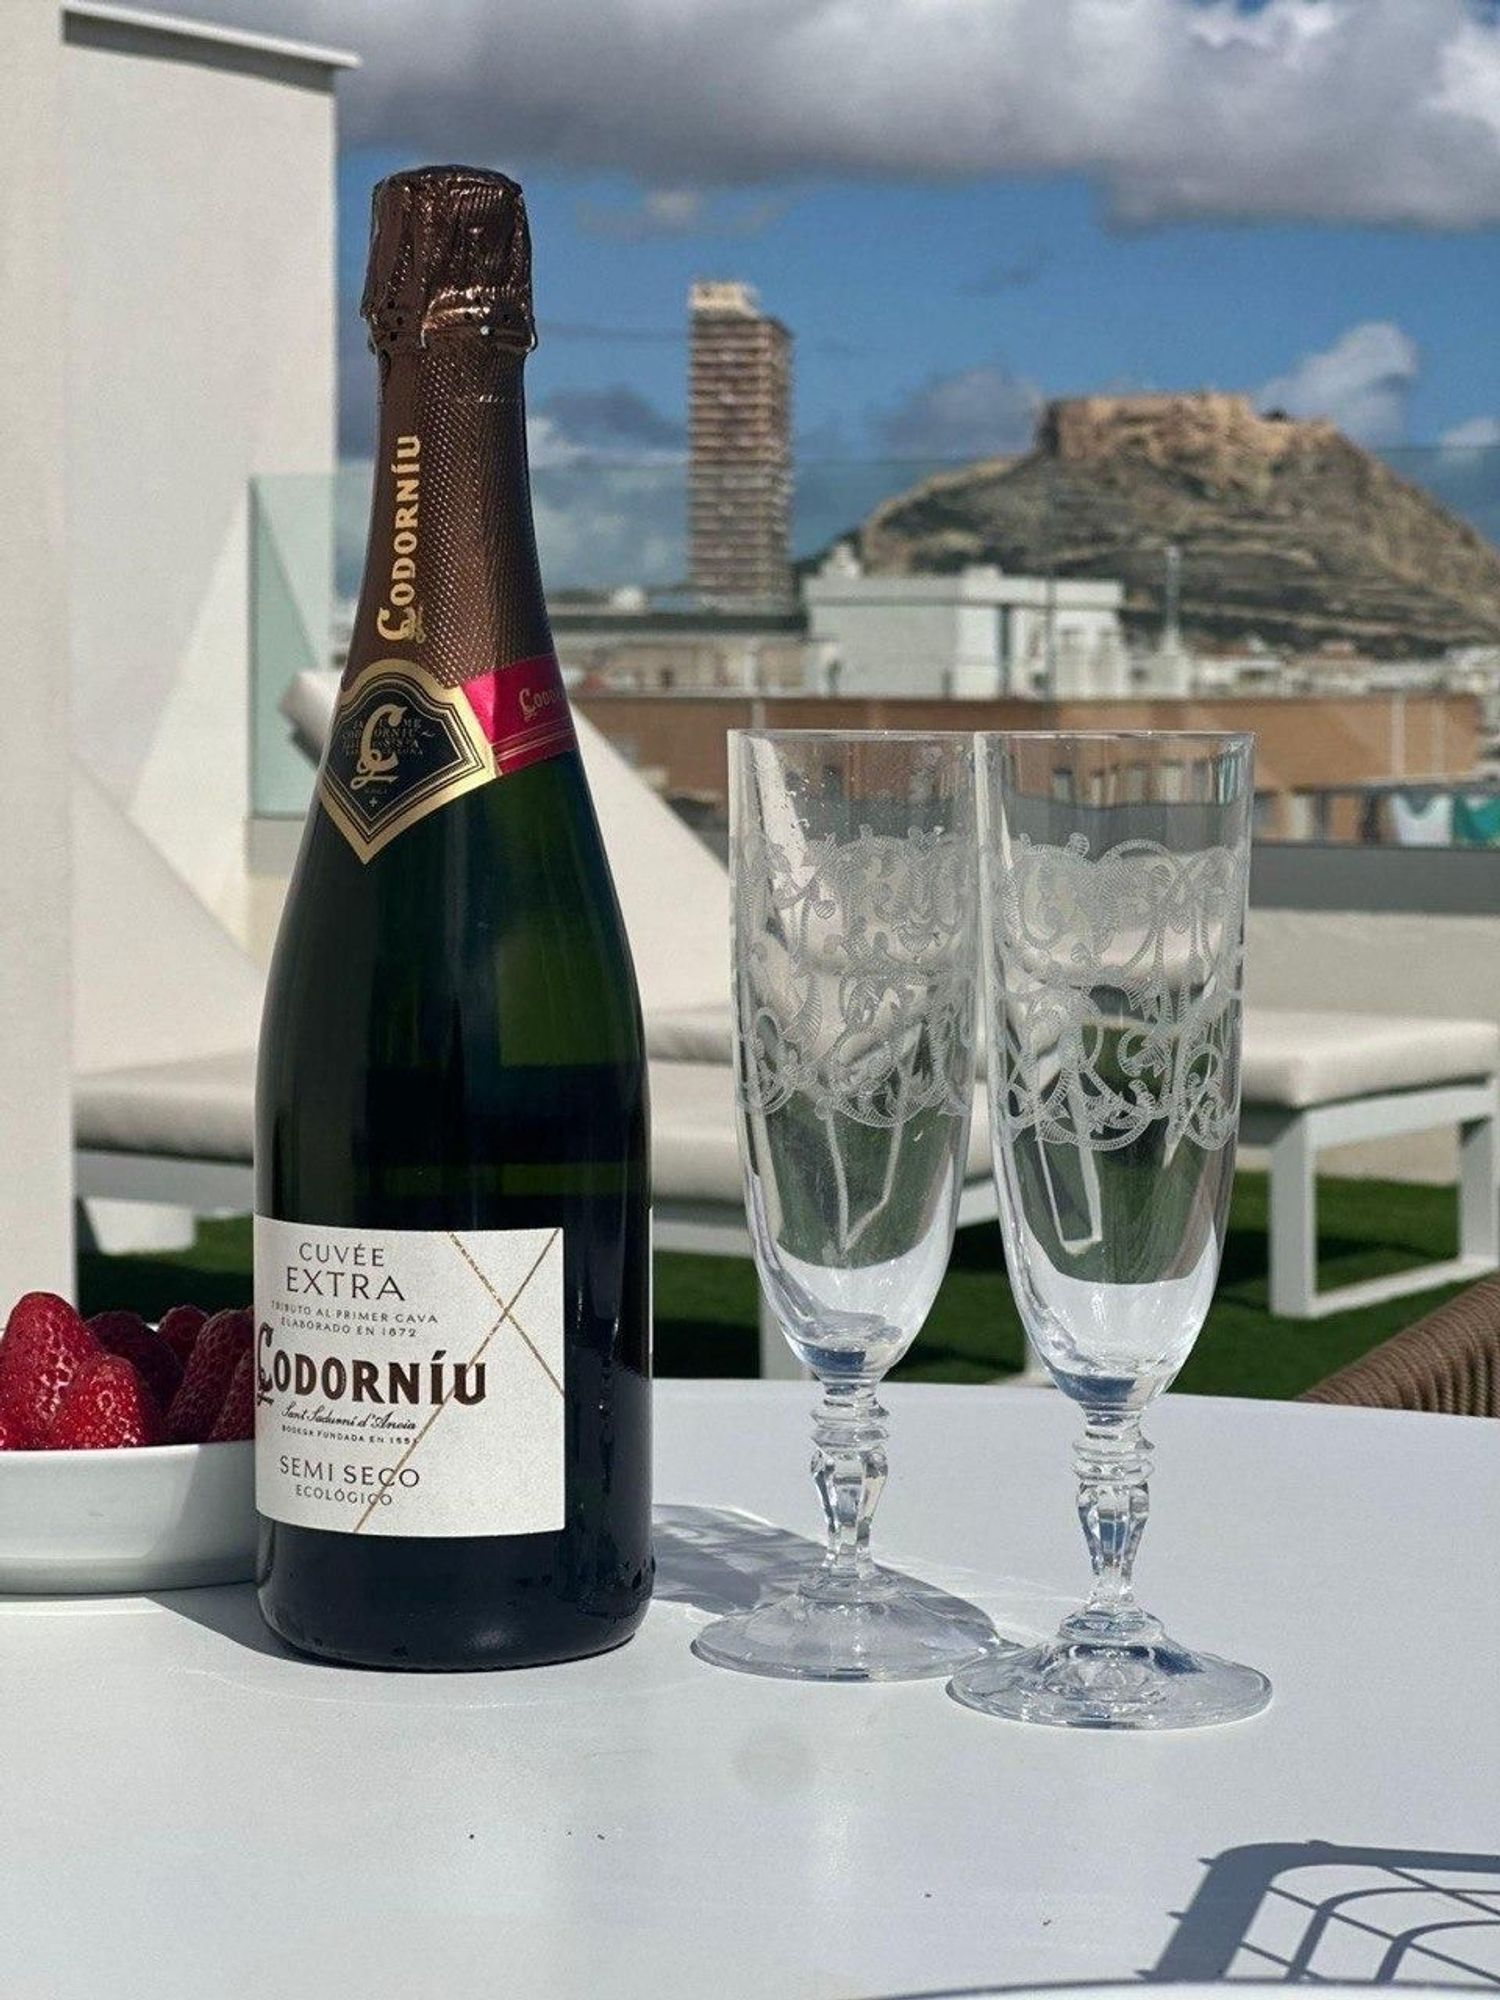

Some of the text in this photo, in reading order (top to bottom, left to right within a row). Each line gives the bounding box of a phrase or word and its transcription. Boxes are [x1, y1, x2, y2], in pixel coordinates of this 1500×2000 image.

[376, 435, 426, 644] CODORNÍU
[298, 1242, 385, 1267] CUVÉE
[286, 1266, 406, 1301] EXTRA
[271, 1300, 438, 1324] TRIBUTO AL PRIMER CAVA
[281, 1316, 417, 1338] ELABORADO EN 1872
[256, 1322, 487, 1407] CODORNÍU
[280, 1401, 309, 1421] Sant
[281, 1424, 314, 1437] BODEGA
[317, 1429, 365, 1443] FUNDADA
[369, 1434, 385, 1444] EN
[279, 1455, 420, 1488] SEMI SECO
[295, 1484, 393, 1506] ECOLÓGICO
